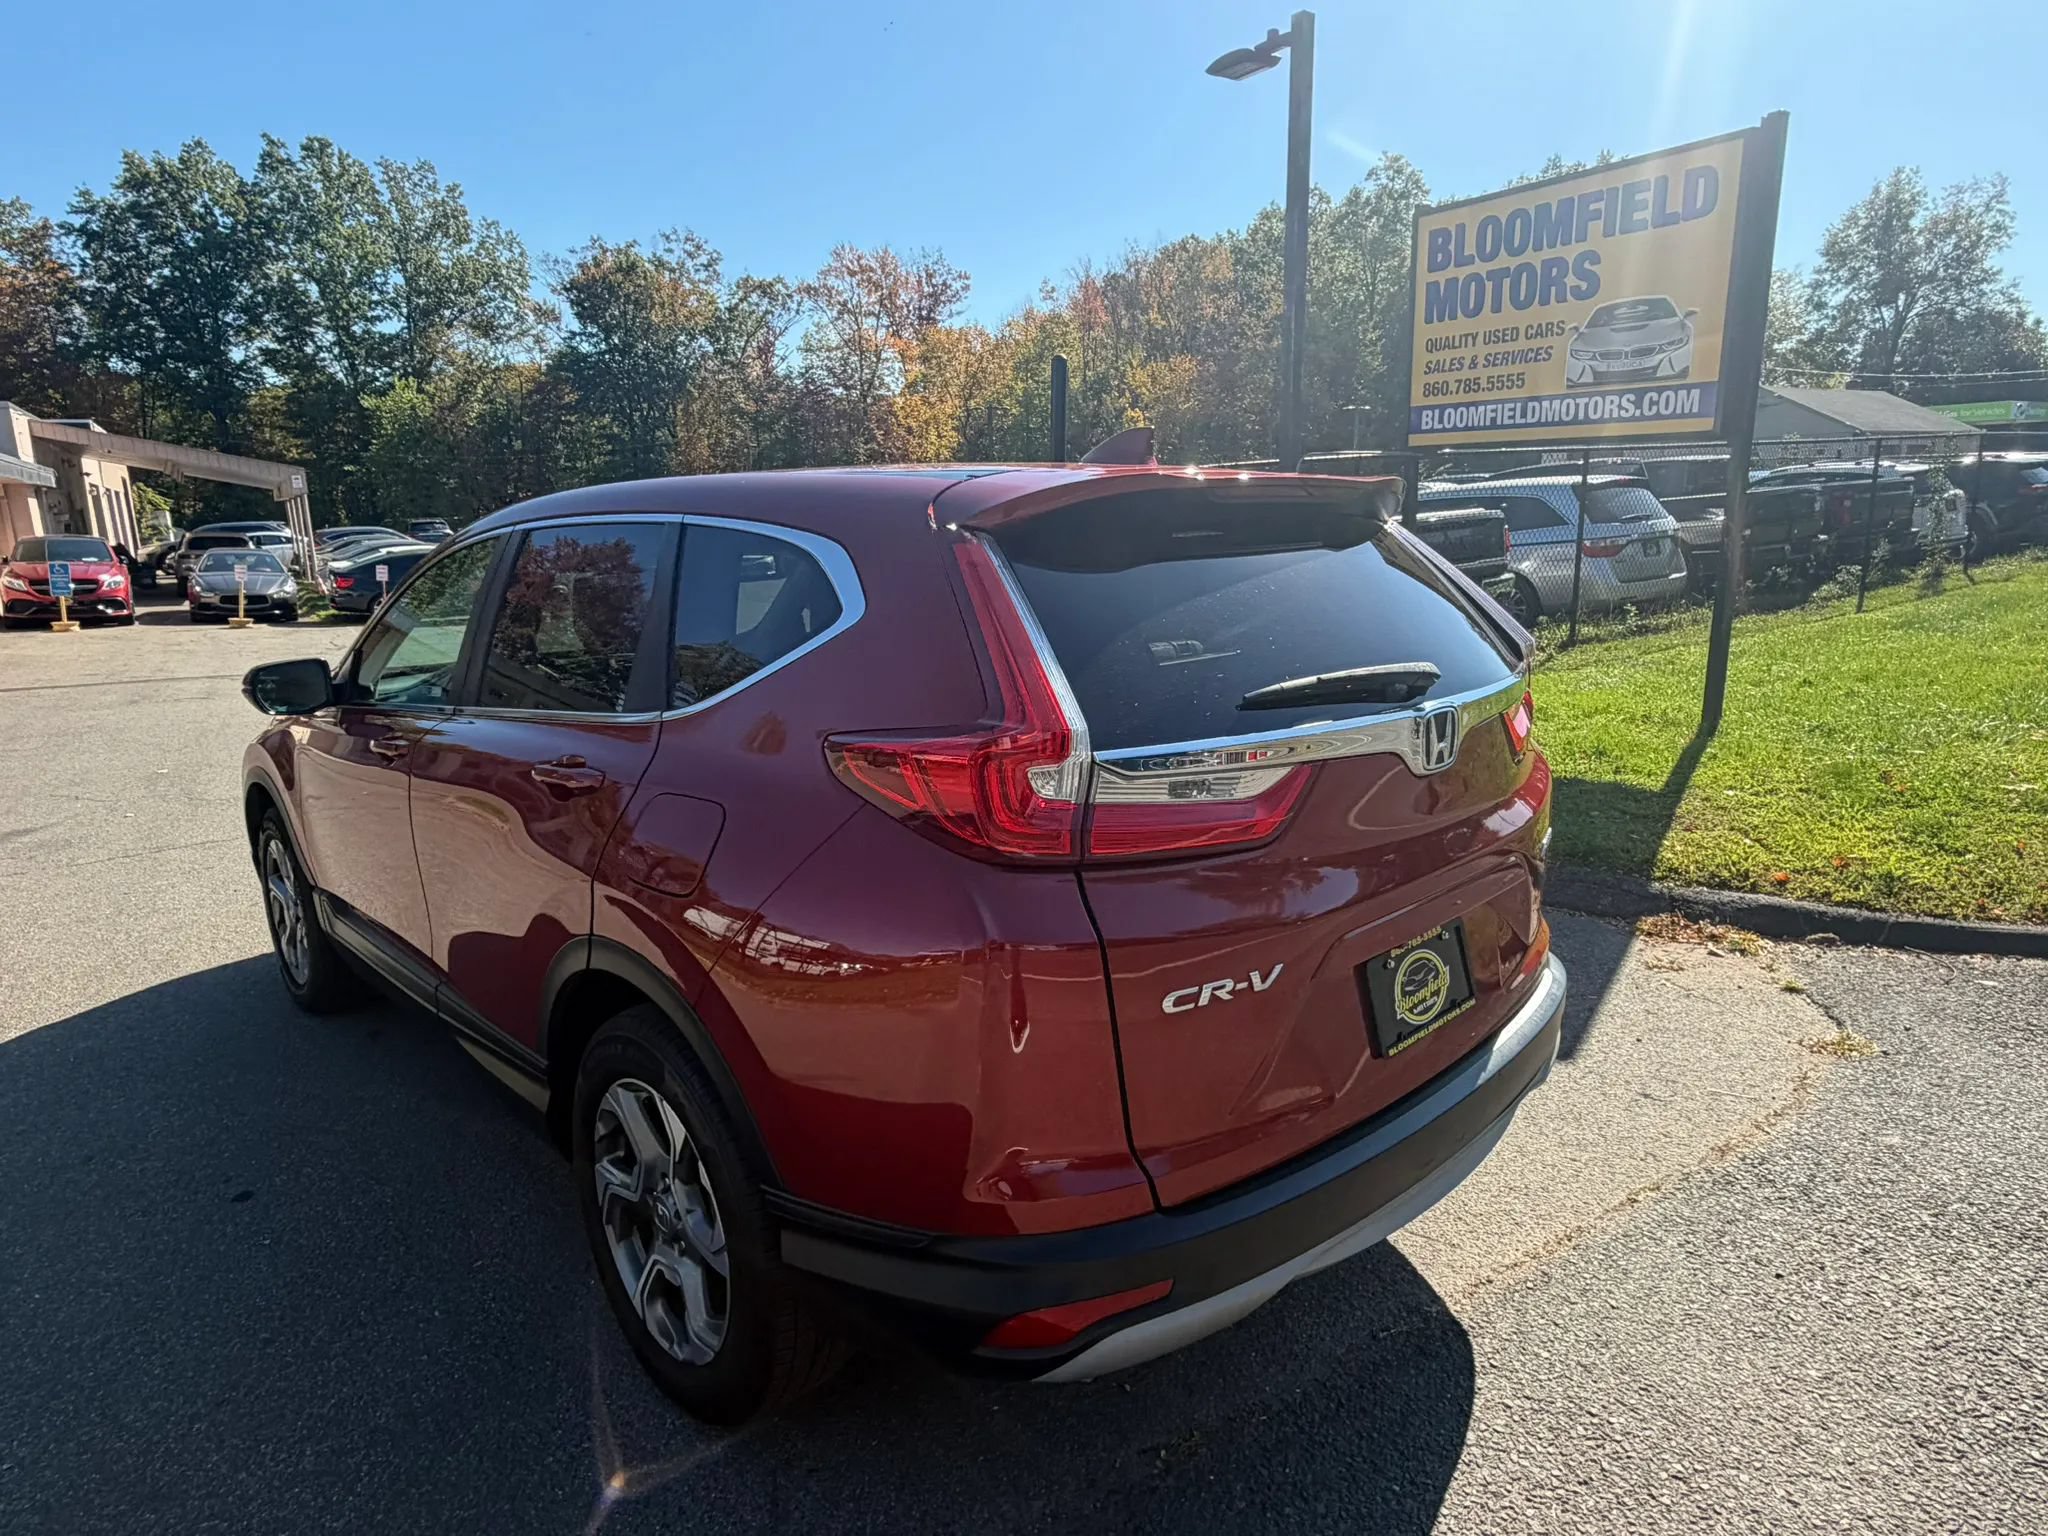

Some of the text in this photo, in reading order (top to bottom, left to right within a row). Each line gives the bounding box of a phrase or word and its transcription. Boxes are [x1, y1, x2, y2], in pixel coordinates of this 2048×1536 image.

[1427, 165, 1719, 273] BLOOMFIELD
[1424, 250, 1602, 325] MOTORS
[1425, 320, 1566, 354] QUALITY USED CARS
[1423, 345, 1553, 376] SALES & SERVICES
[1422, 372, 1526, 398] 860.785.5555
[1420, 388, 1700, 431] BLOOMFIELDMOTORS.COM
[1162, 963, 1284, 1013] CR-V
[1400, 972, 1449, 1013] Bloomfield
[1388, 998, 1476, 1057] BLOOMFIELDMOTORS.COM
